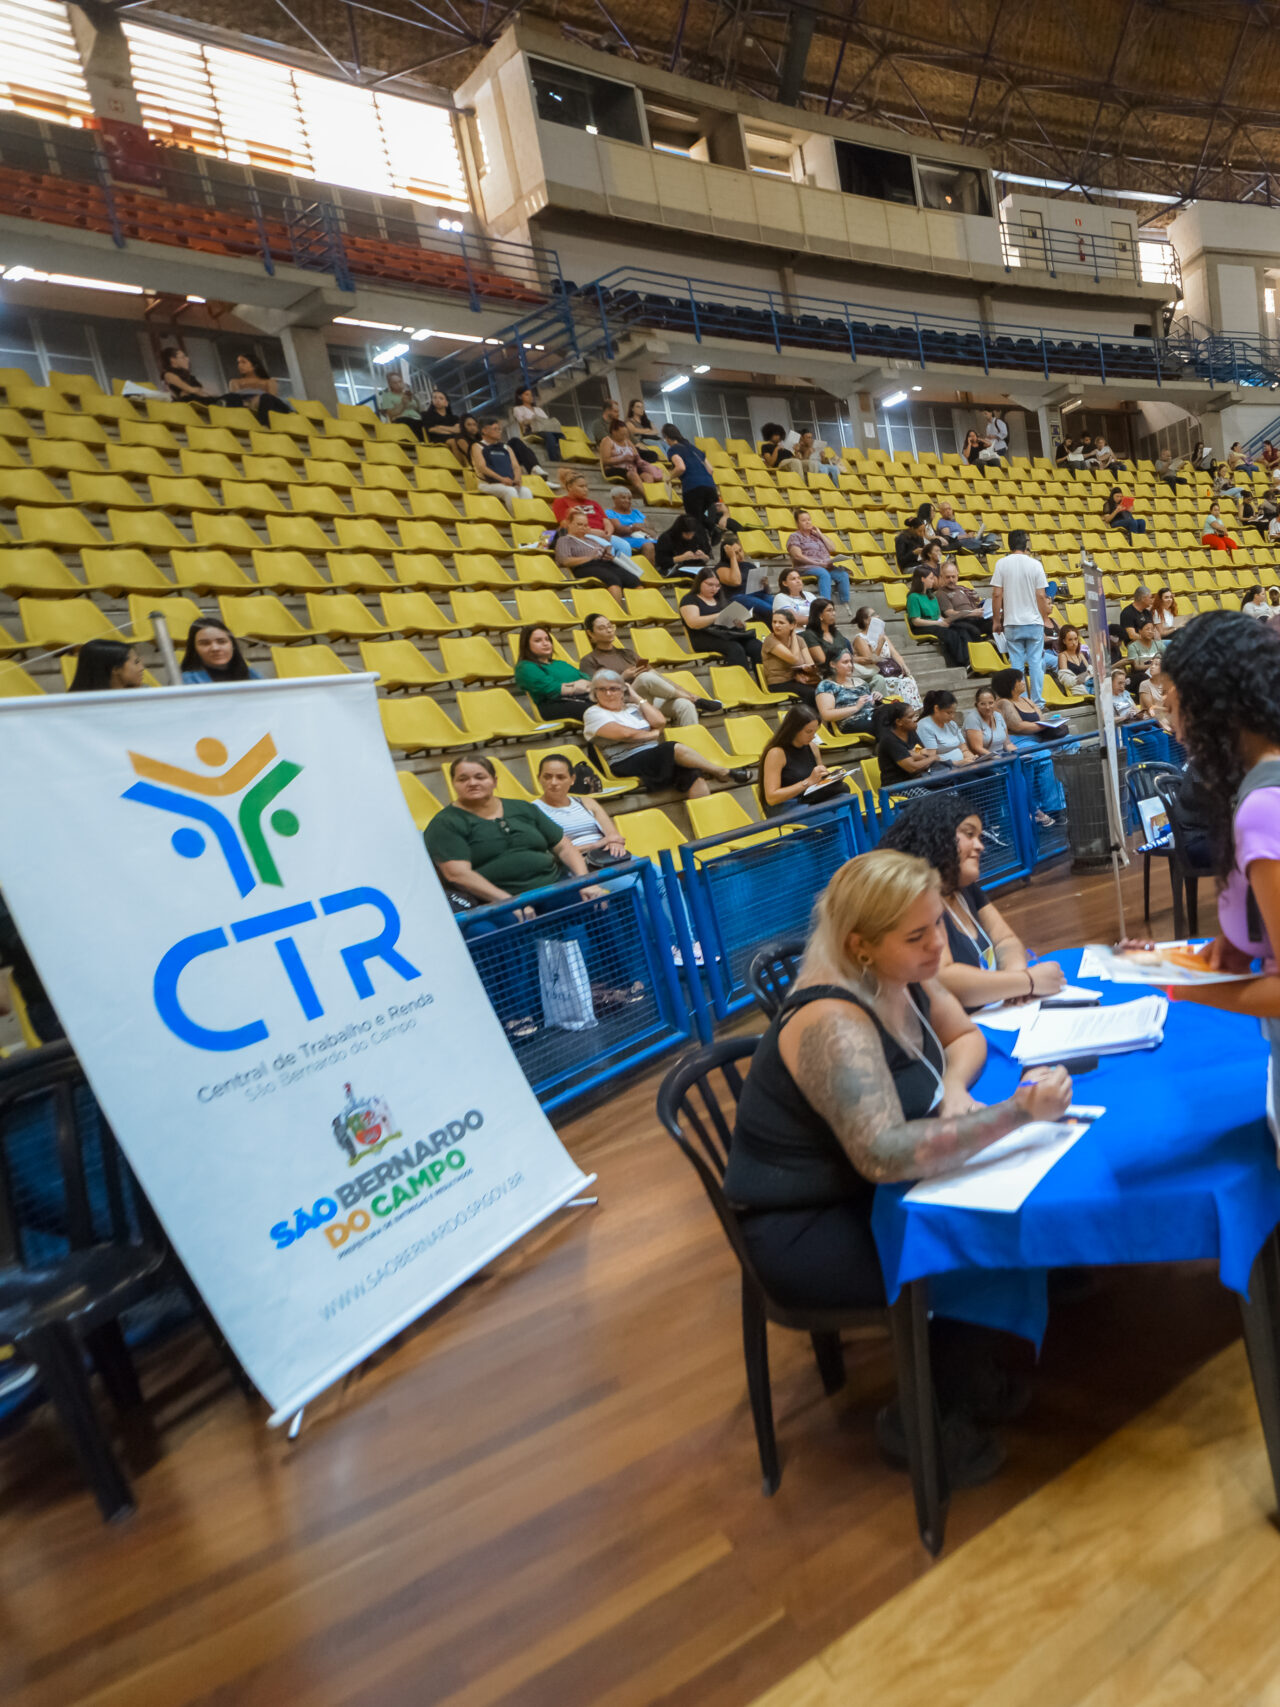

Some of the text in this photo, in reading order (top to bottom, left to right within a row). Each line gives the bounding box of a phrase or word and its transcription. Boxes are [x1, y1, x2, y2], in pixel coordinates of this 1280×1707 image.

[1141, 836, 1169, 851] ESTAM
[153, 886, 422, 1051] CTR
[197, 992, 434, 1102] Central de Trabalho e Renda
[245, 1018, 417, 1101] São Bernardo do Campo
[269, 1109, 484, 1250] SÃO BERNARDO
[323, 1149, 465, 1249] DO CAMPO
